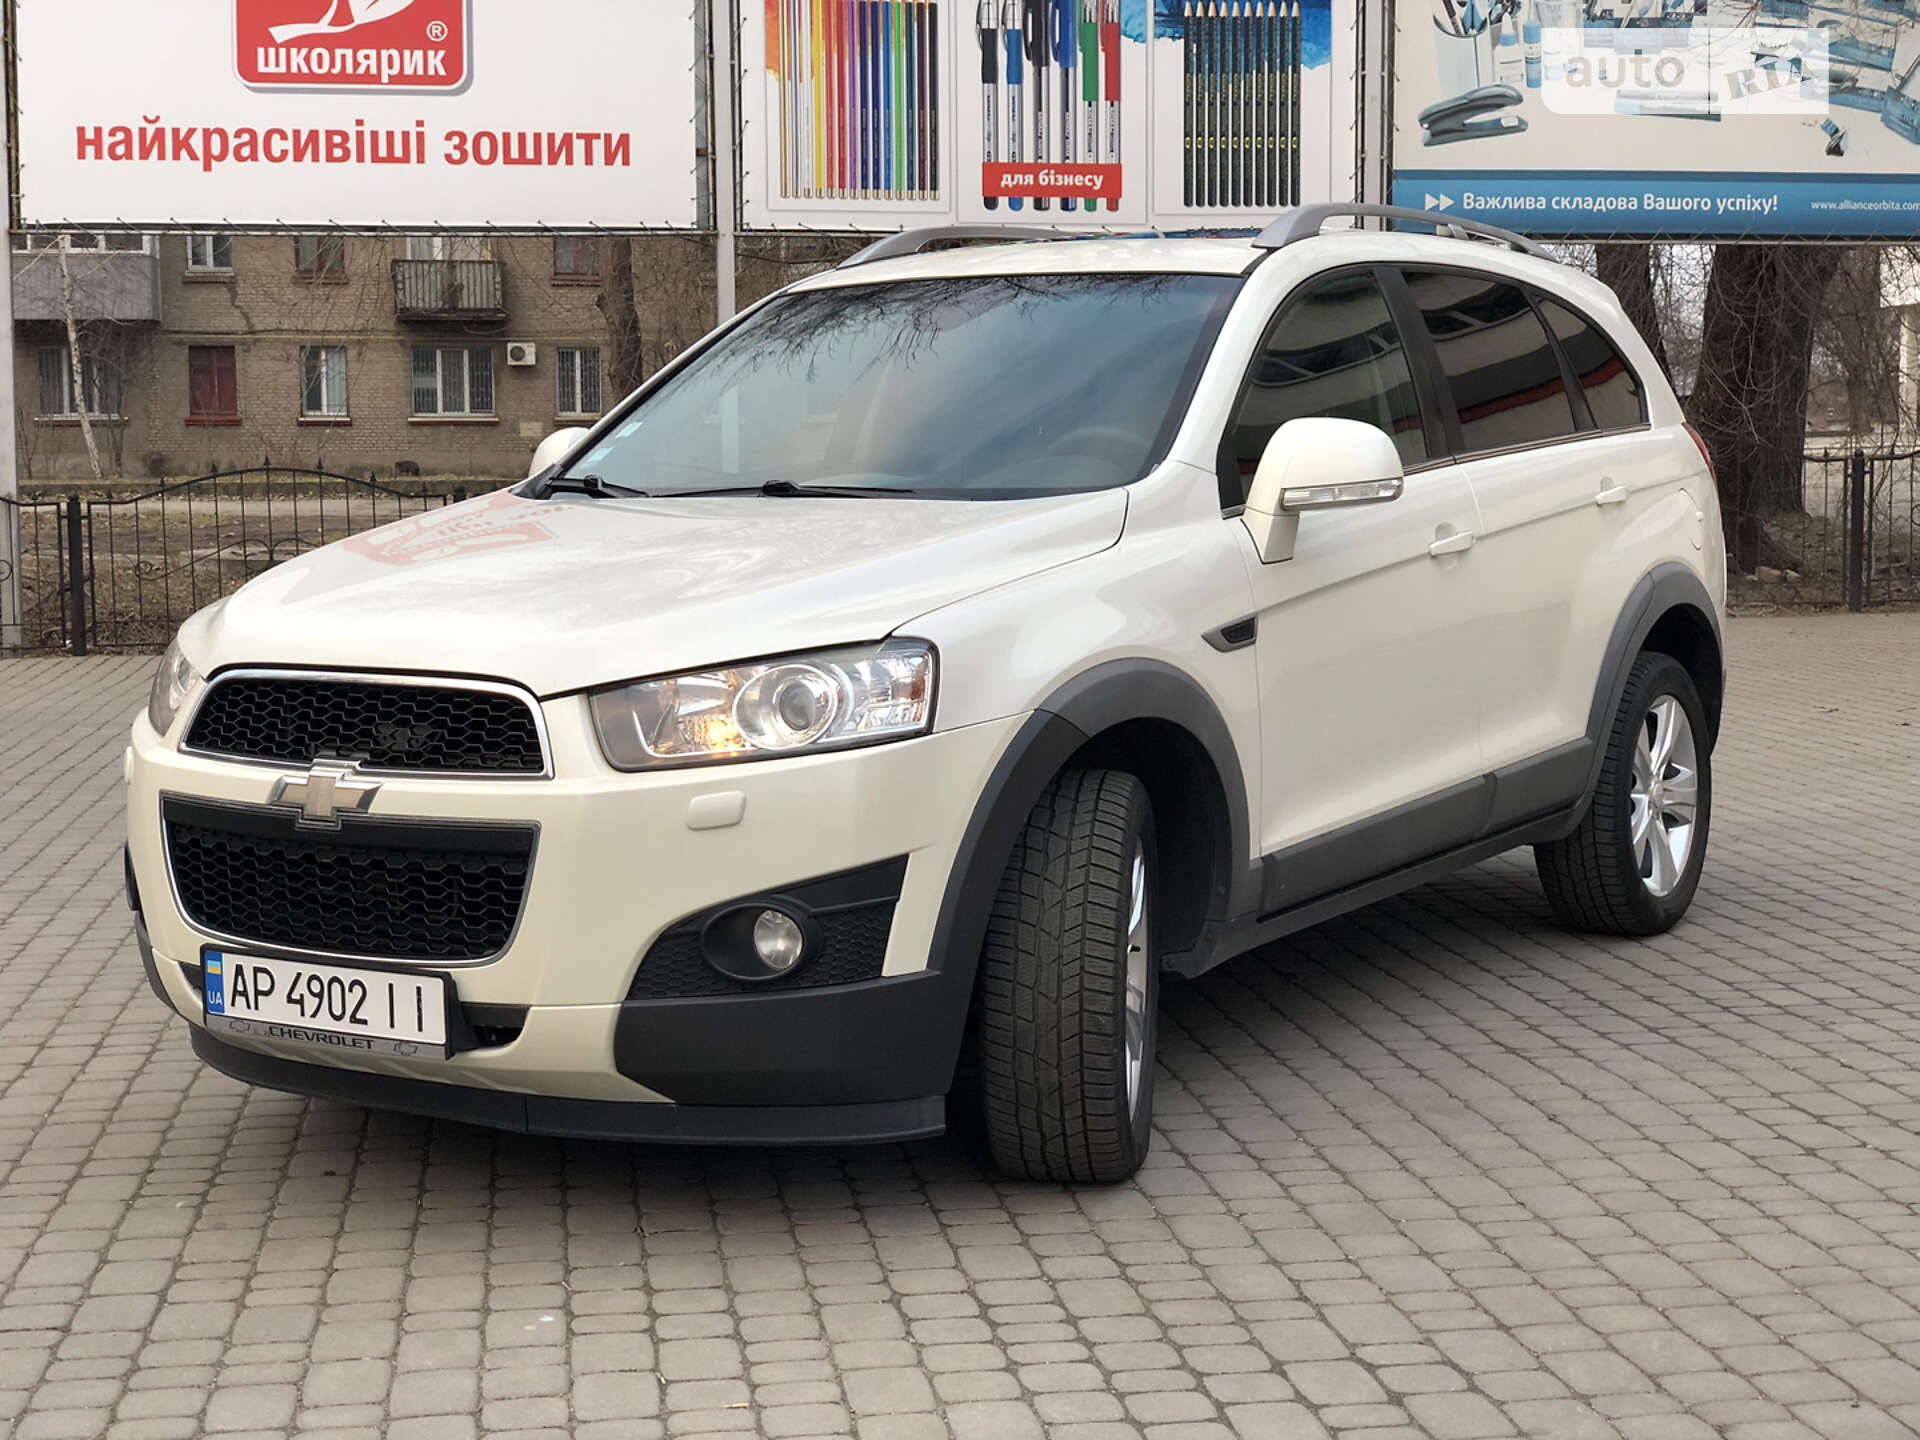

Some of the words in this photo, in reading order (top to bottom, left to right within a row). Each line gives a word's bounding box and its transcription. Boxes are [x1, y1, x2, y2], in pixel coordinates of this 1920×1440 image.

[256, 46, 447, 82] школярик
[76, 115, 425, 172] найкрасивіші
[443, 131, 631, 167] зошити
[1000, 173, 1034, 188] для
[1038, 169, 1103, 191] бізнесу
[1463, 192, 1547, 210] Важлива
[1551, 194, 1638, 213] складова
[1643, 193, 1711, 211] Вашого
[1716, 194, 1778, 216] успіху!
[208, 990, 223, 1006] UA
[230, 963, 275, 1011] AP
[286, 971, 368, 1026] 4902
[269, 1026, 374, 1049] CHEVROLET
